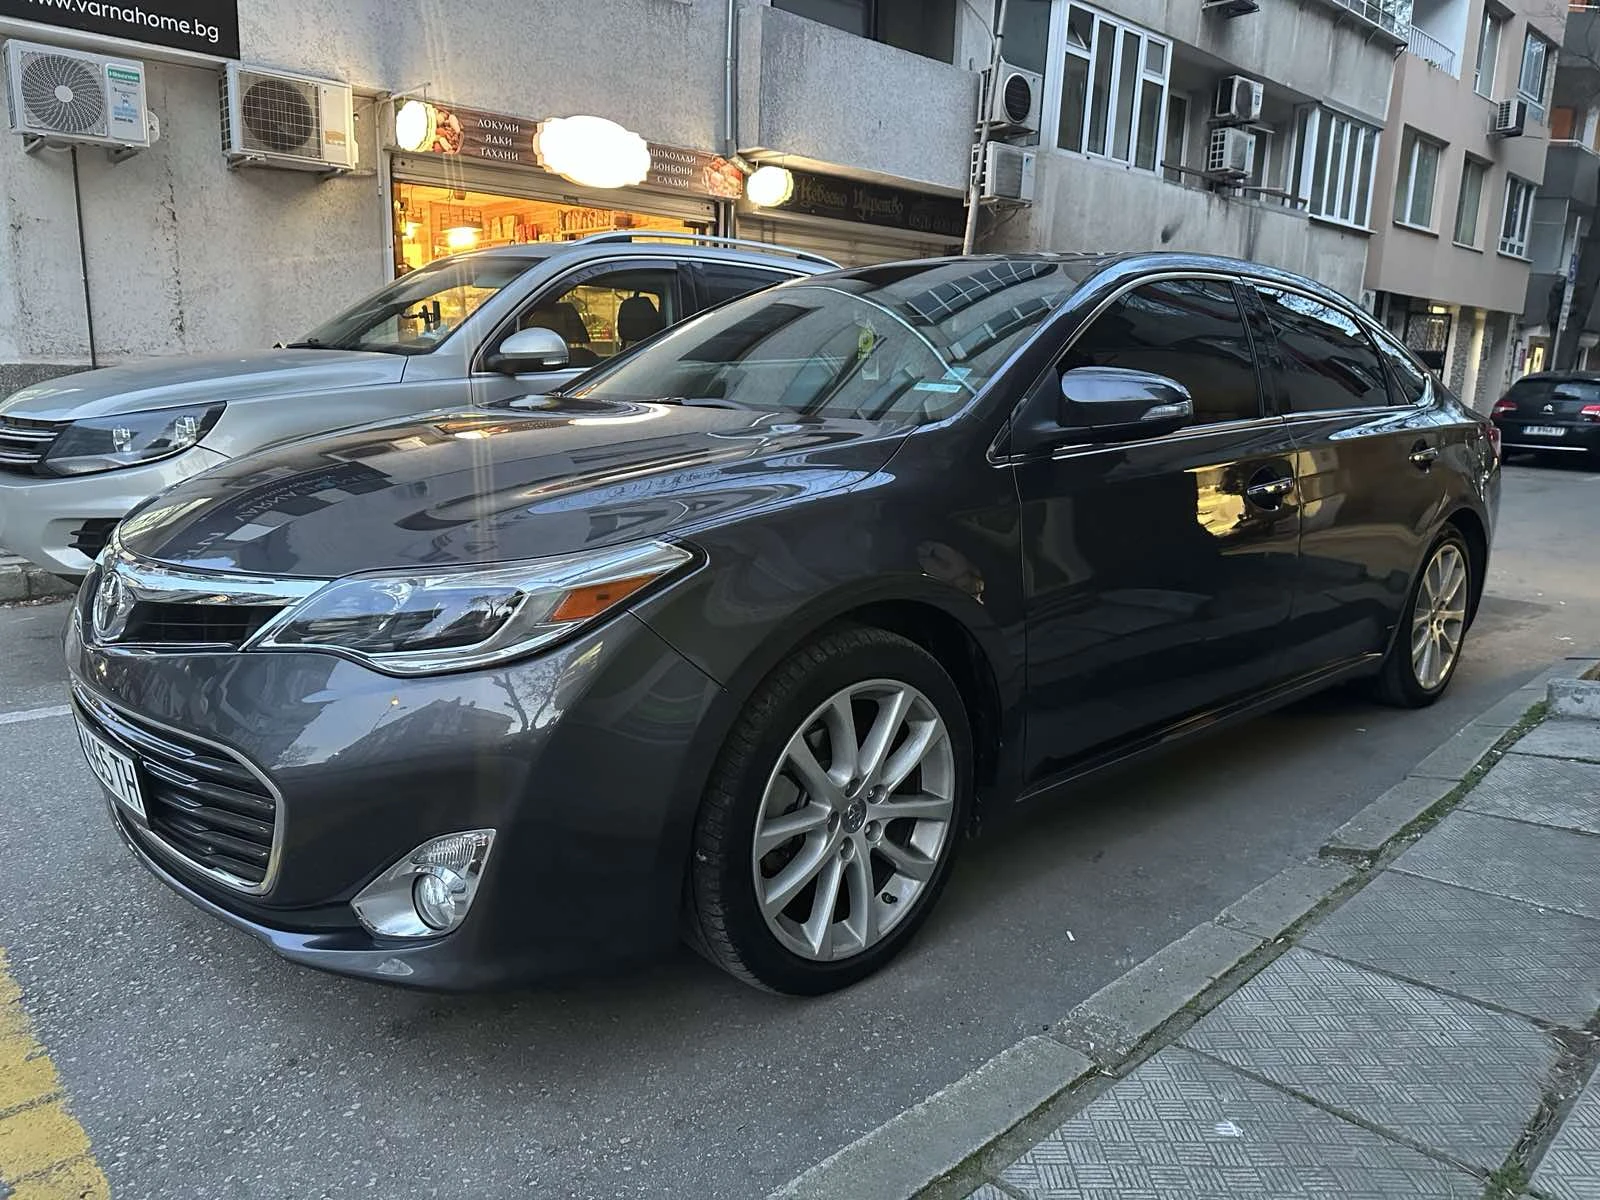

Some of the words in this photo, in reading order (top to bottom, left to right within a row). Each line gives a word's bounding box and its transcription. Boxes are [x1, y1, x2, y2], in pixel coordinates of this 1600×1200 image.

[29, 0, 219, 42] w.varnahome.bg
[477, 118, 519, 133] ЛОКУМИ
[485, 134, 512, 146] ЯДКИ
[480, 147, 519, 161] ТАХАНИ
[650, 147, 696, 164] ШОКОЛАДИ
[653, 161, 693, 176] БОНБОНИ
[657, 175, 689, 188] СЛАДКИ
